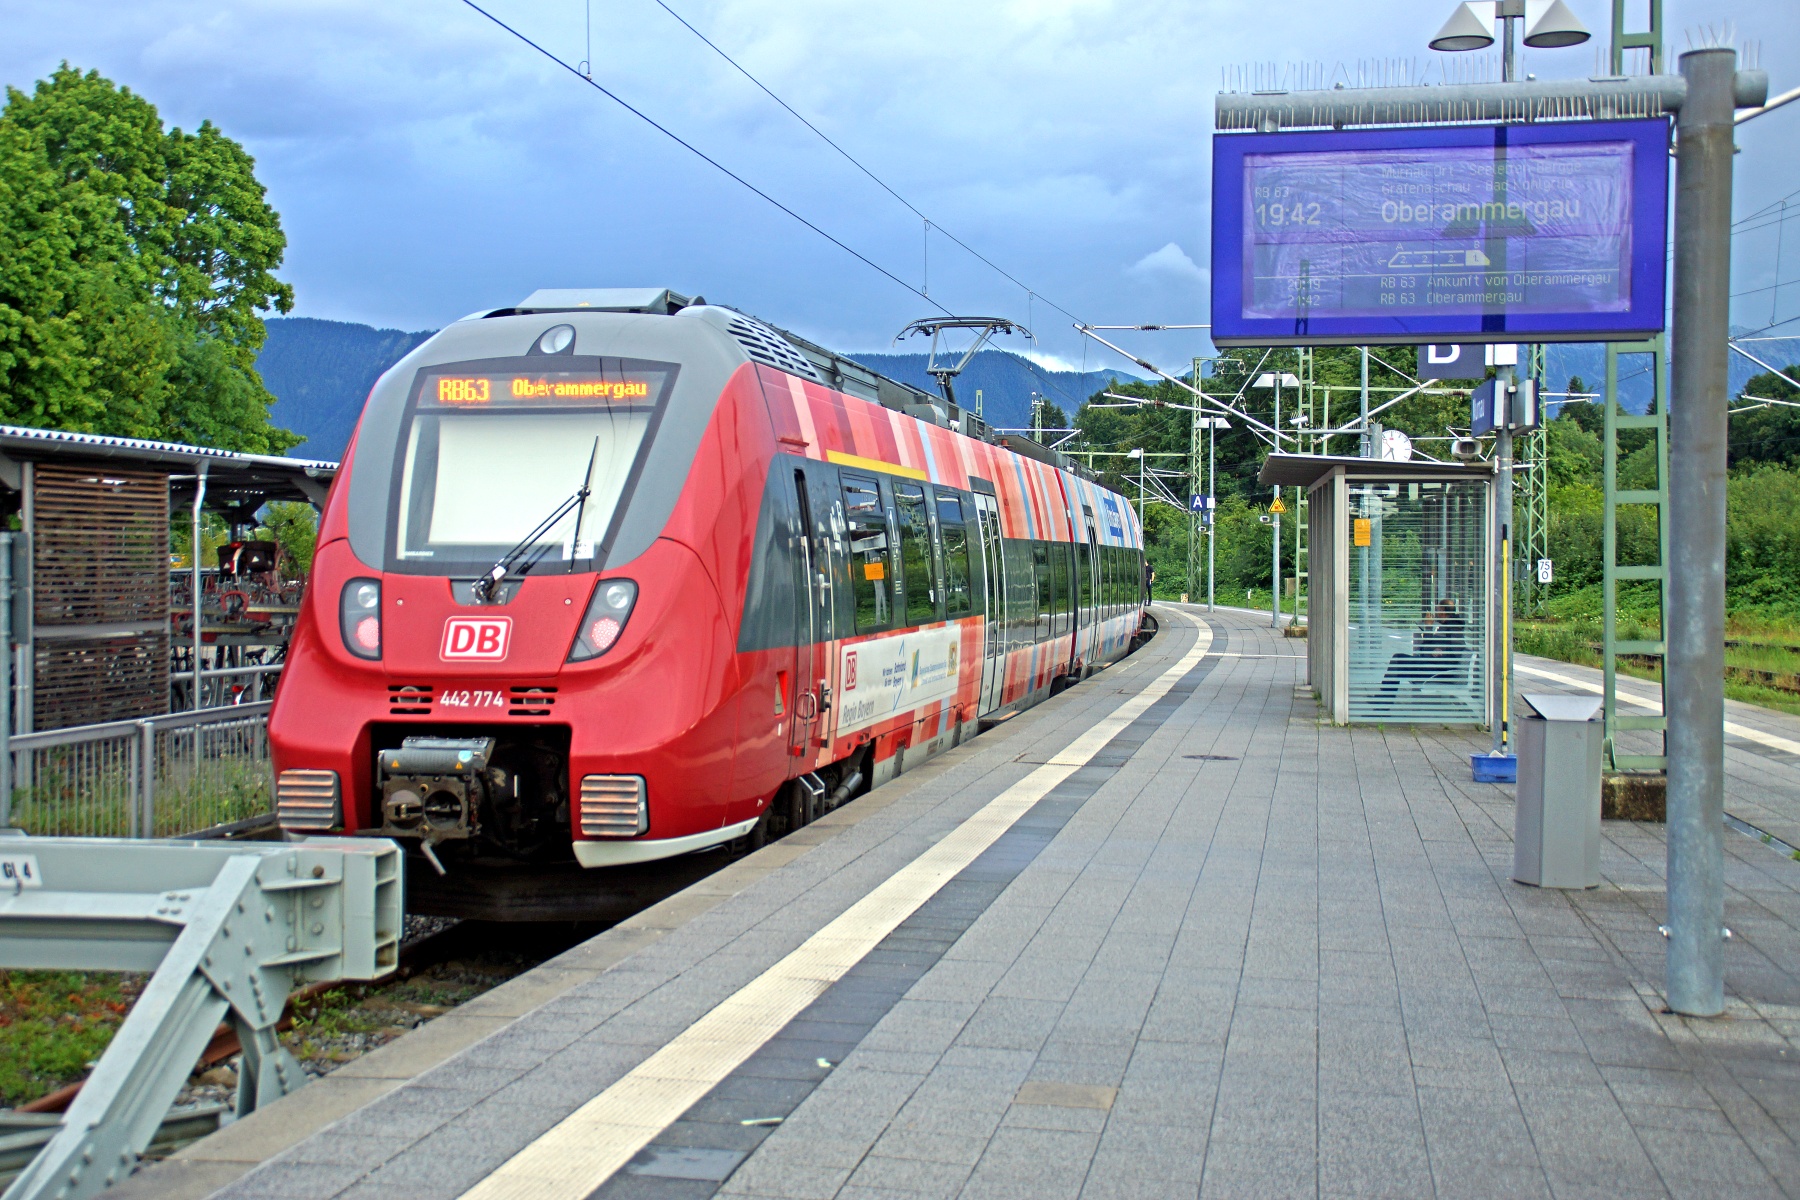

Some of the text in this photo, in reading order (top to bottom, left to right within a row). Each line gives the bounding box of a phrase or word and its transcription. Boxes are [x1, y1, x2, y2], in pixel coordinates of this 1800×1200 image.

[1255, 186, 1270, 198] RB
[1485, 179, 1508, 192] Bad
[1256, 199, 1580, 226] 19:42 Oberammergau
[1380, 277, 1396, 289] RB
[1400, 276, 1416, 288] 63
[1427, 274, 1479, 288] Ankunft
[1485, 277, 1508, 287] von
[1513, 272, 1611, 287] Oberammergau
[1287, 290, 1522, 306] 21:42 RB 63 Oberammergau
[439, 378, 647, 401] RB63 Oberammergau
[1192, 495, 1203, 509] A
[1539, 561, 1550, 571] 75
[1541, 570, 1549, 580] 0
[450, 624, 501, 653] DB
[846, 658, 856, 685] DB
[440, 690, 503, 708] 442 774
[23, 862, 32, 879] 4
